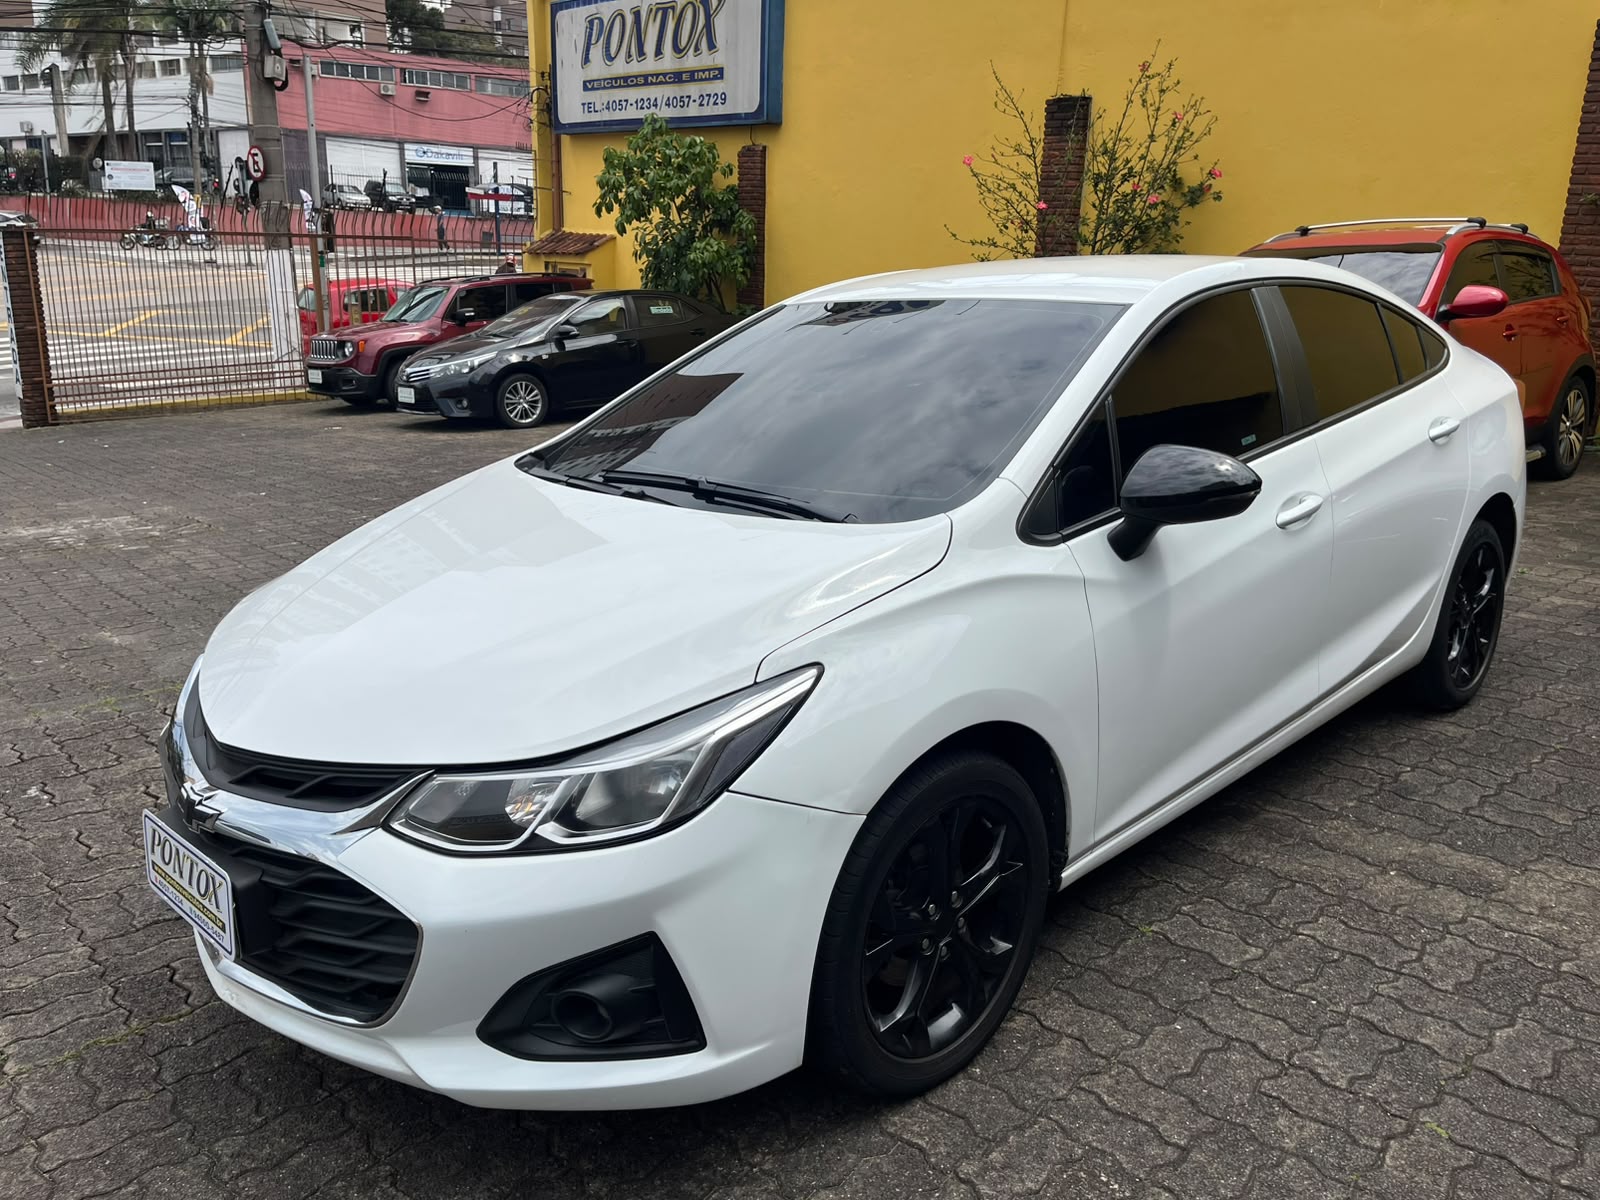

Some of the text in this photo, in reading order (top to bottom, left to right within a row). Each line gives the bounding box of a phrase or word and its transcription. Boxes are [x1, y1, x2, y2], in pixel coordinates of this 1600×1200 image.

[581, 0, 727, 69] PONTOX
[648, 74, 678, 83] NAC.
[695, 70, 720, 79] IMP.
[151, 828, 222, 913] PONTOX
